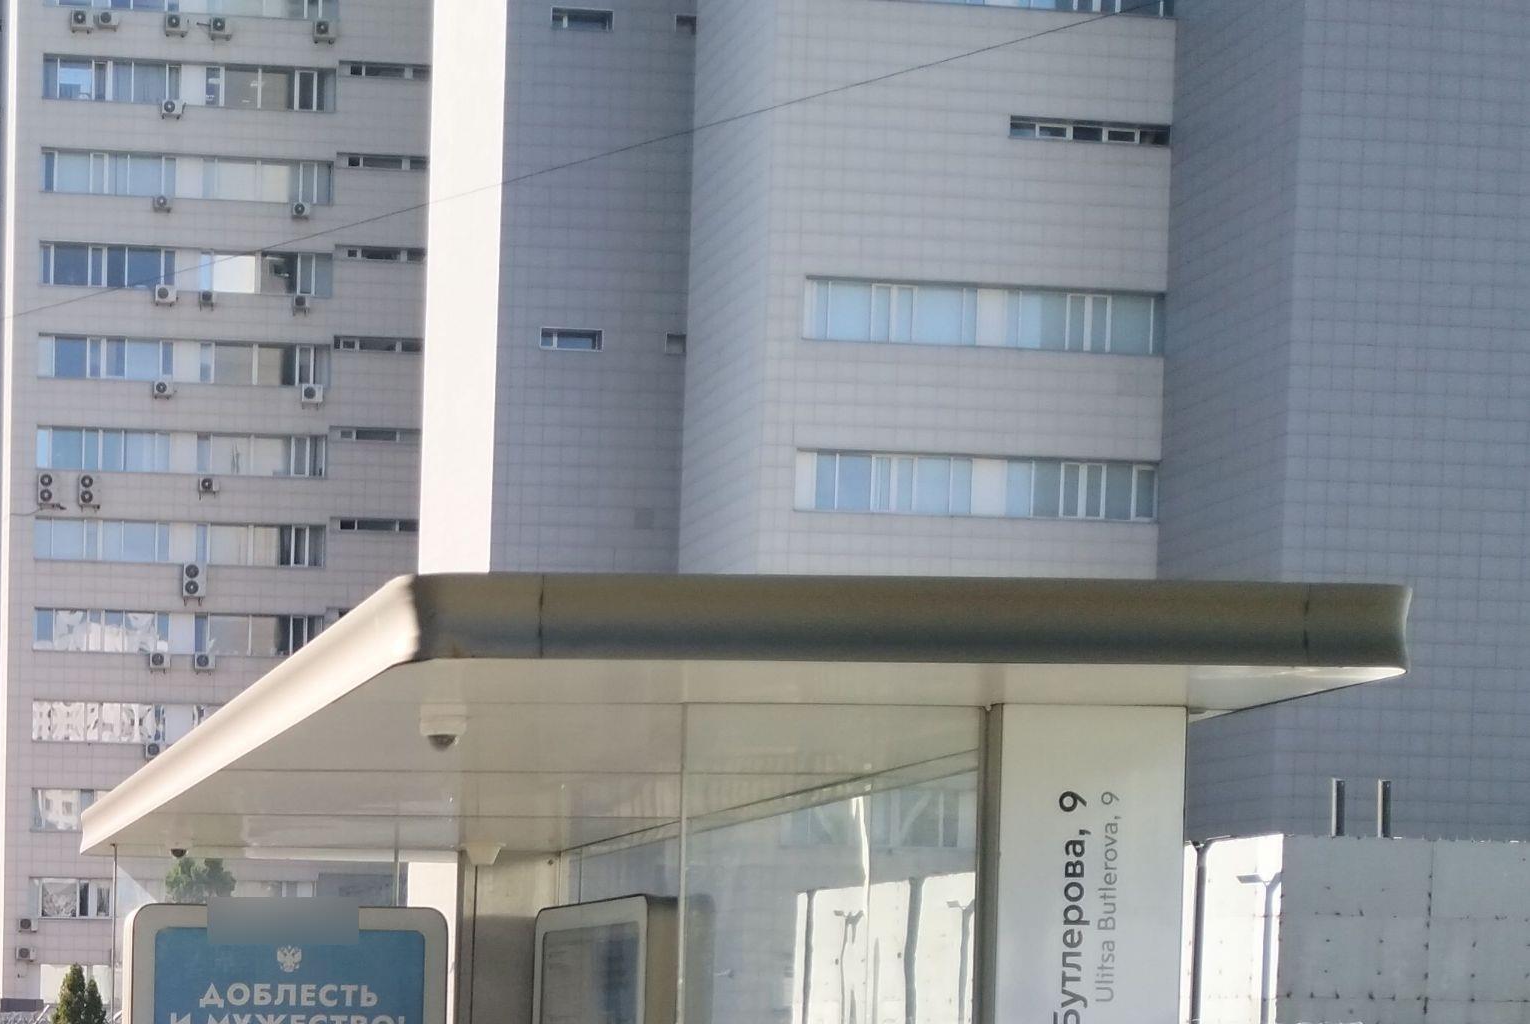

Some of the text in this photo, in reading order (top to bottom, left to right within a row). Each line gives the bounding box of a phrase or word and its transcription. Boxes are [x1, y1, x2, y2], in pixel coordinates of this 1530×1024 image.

[1058, 790, 1088, 813] 9
[1095, 791, 1121, 1002] Ulitsa Butlerova, 9
[199, 982, 378, 1008] ДОБЛЕСТЬ
